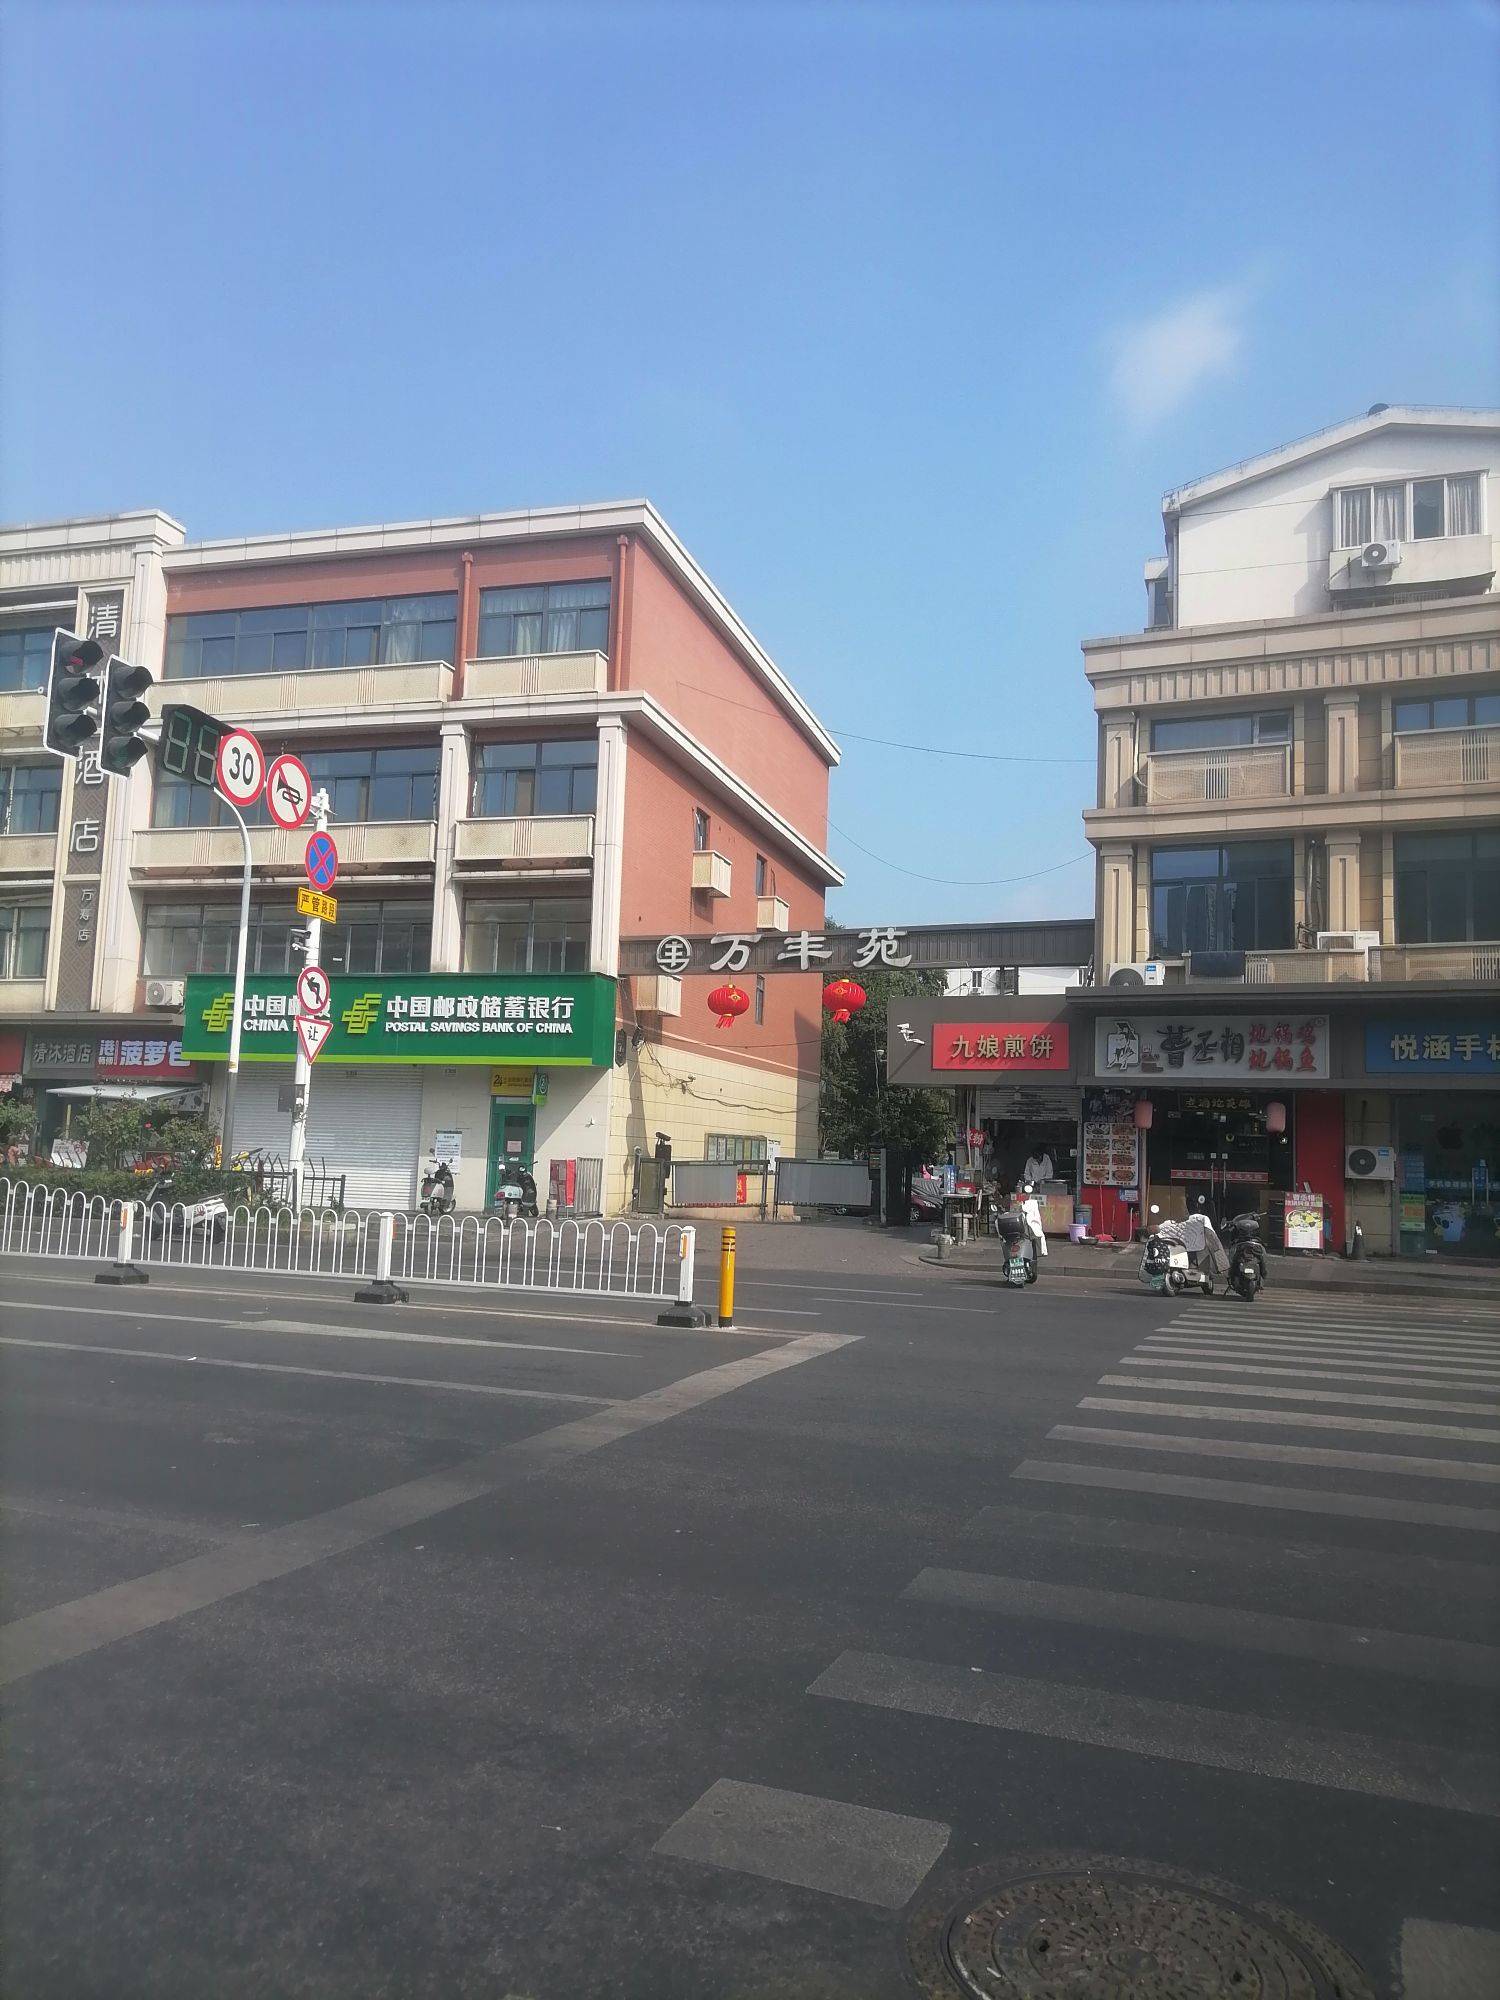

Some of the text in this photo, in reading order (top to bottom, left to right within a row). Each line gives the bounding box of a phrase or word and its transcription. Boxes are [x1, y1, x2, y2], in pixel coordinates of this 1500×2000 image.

[229, 747, 254, 786] 30
[299, 892, 336, 918] 严管路段
[709, 928, 912, 972] 万丰苑
[387, 996, 574, 1018] 中国邮政储蓄银行
[243, 1019, 289, 1032] CHINA
[307, 1025, 318, 1041] 让
[385, 1021, 573, 1034] POSTAL SAVINGS BANK OF CHINA
[33, 1043, 91, 1063] 清沐酒店
[951, 1034, 1054, 1059] 九娘煎饼
[1249, 1047, 1317, 1072] 地锅鱼
